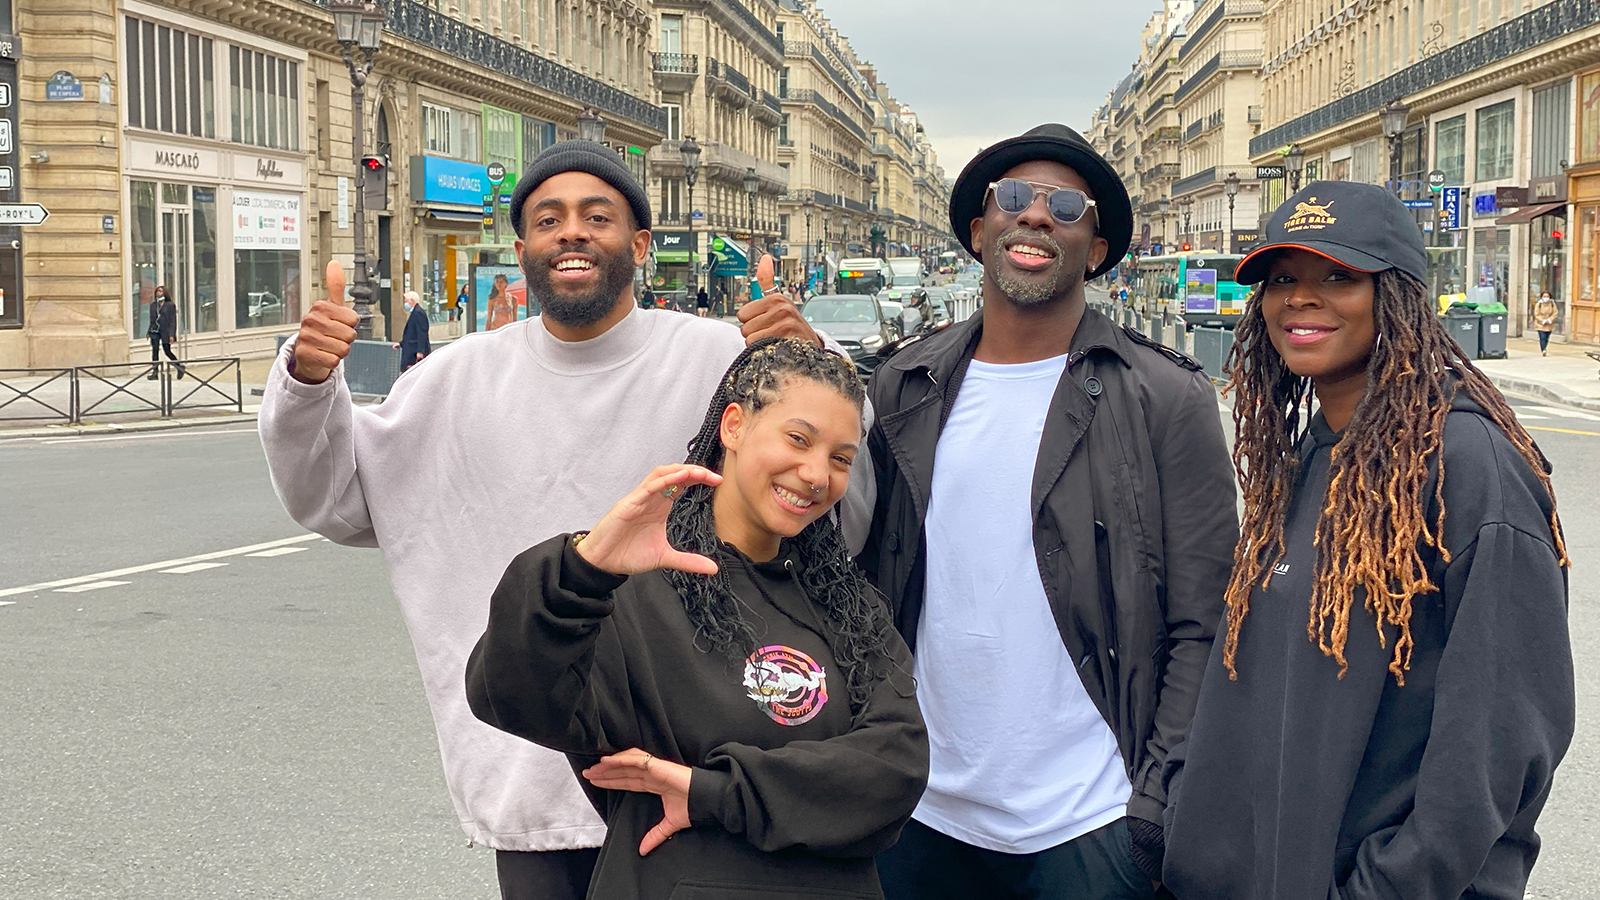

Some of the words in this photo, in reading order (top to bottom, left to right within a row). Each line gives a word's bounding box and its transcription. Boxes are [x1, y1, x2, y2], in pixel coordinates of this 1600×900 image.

[155, 150, 200, 169] MASCARÓ
[489, 167, 504, 176] BUS
[1258, 167, 1282, 175] BOSS
[437, 174, 457, 190] HAVAS
[458, 176, 481, 193] VOYAGES
[1430, 174, 1444, 183] BUS
[1446, 189, 1456, 228] CHANGE
[1283, 217, 1307, 229] TIGER
[1308, 216, 1337, 225] BALM
[663, 235, 681, 246] jour
[1237, 234, 1258, 242] BNP
